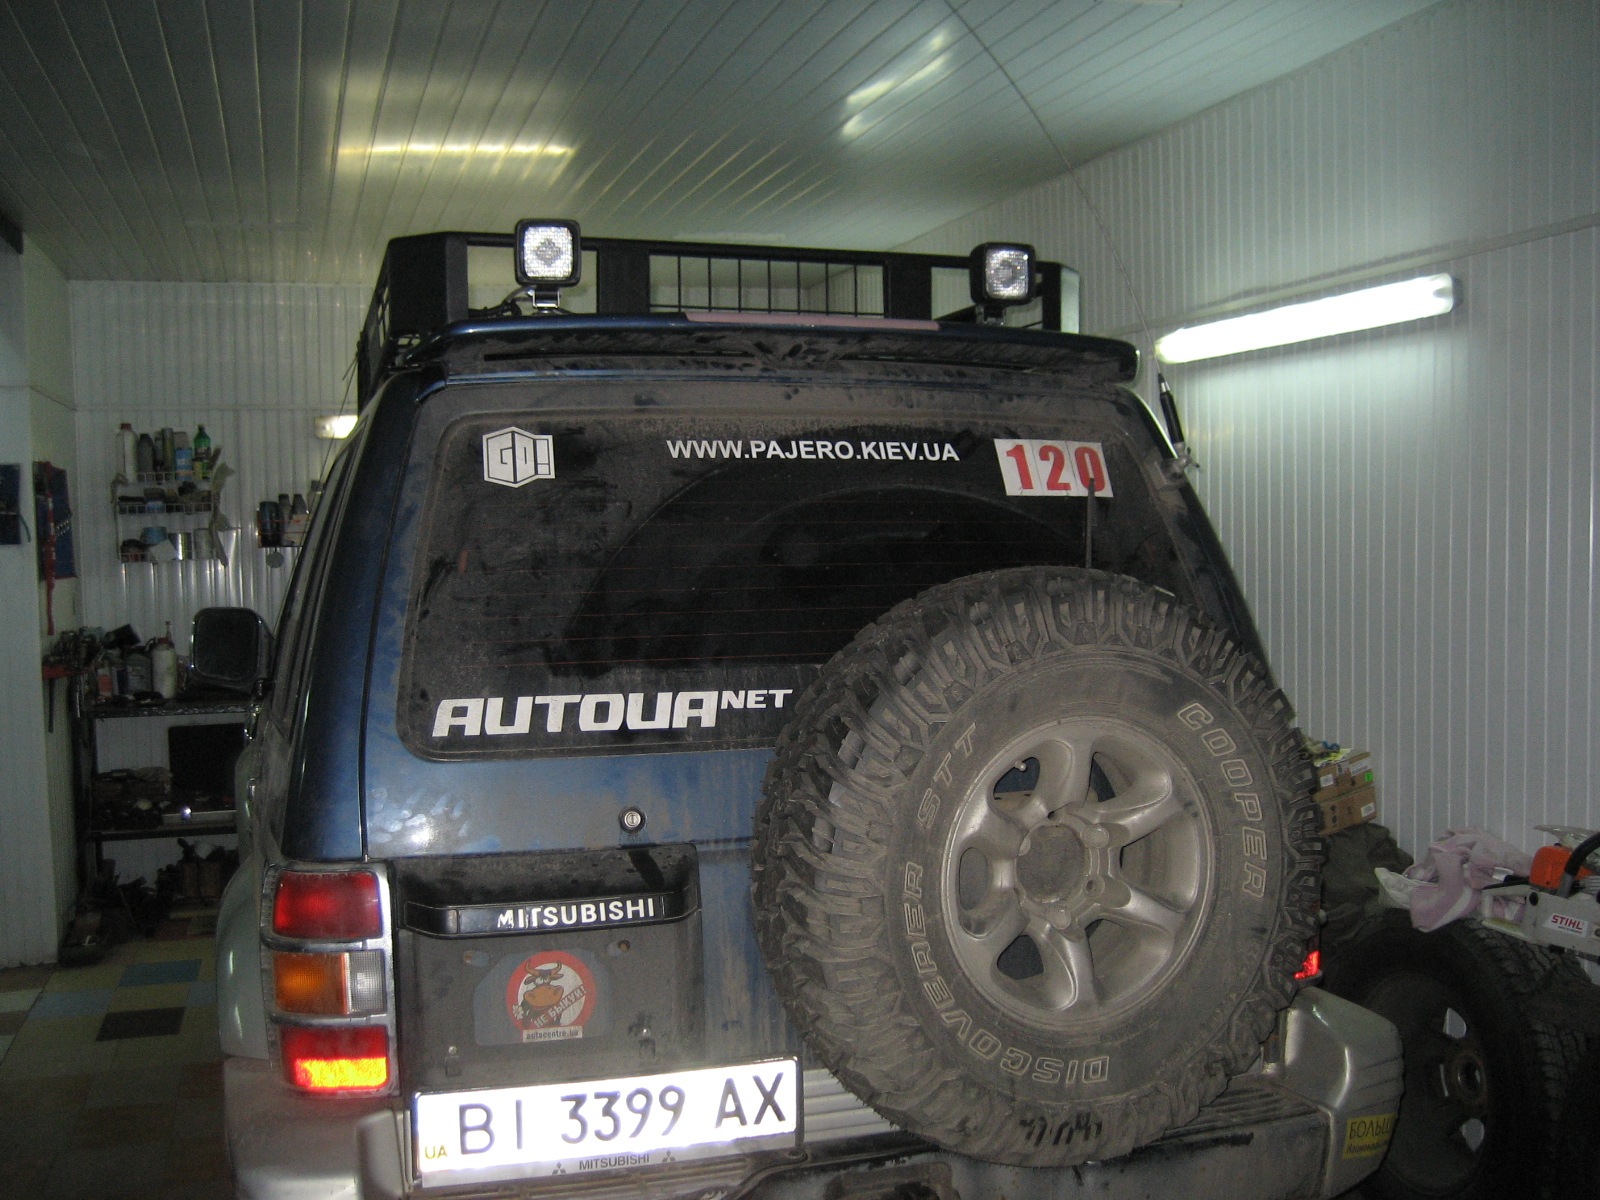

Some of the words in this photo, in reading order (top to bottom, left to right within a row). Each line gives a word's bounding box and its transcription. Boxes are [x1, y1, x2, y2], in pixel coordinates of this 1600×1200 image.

[666, 440, 960, 461] WWW.PAJERO.KIEV.UA
[1006, 444, 1105, 492] 120
[432, 691, 719, 737] AUTOUA
[721, 689, 793, 710] NET
[917, 722, 977, 830] STT
[1177, 702, 1268, 899] COOPER
[497, 898, 655, 929] MITSUBISHI
[1551, 914, 1583, 931] STIHL
[903, 861, 1110, 1085] DISCOVERER
[560, 1085, 686, 1144] 3399
[715, 1072, 787, 1128] AX
[425, 1145, 448, 1160] UA
[579, 1153, 650, 1171] MITSUBISHI
